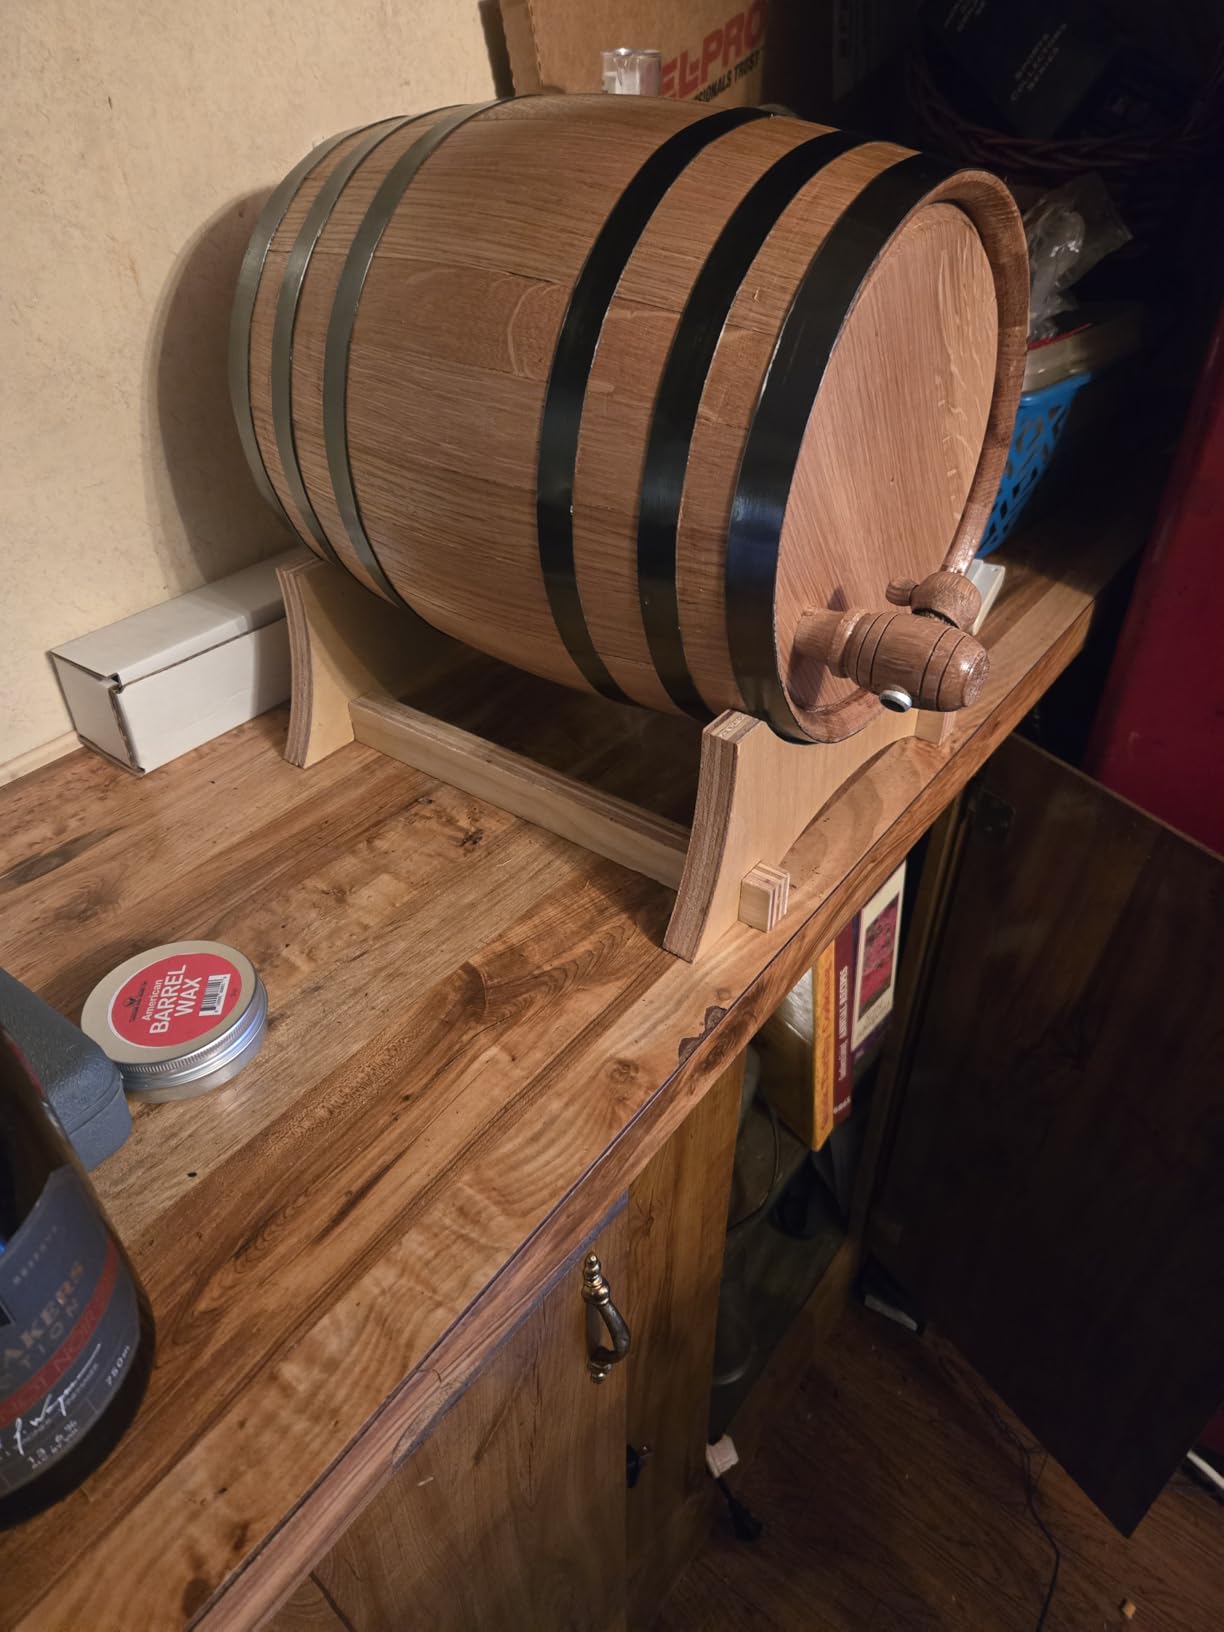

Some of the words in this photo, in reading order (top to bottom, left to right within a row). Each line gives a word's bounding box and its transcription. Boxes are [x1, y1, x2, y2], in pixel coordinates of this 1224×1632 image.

[142, 979, 163, 1021] American
[149, 964, 187, 1035] BARREL
[174, 976, 202, 1017] WAX
